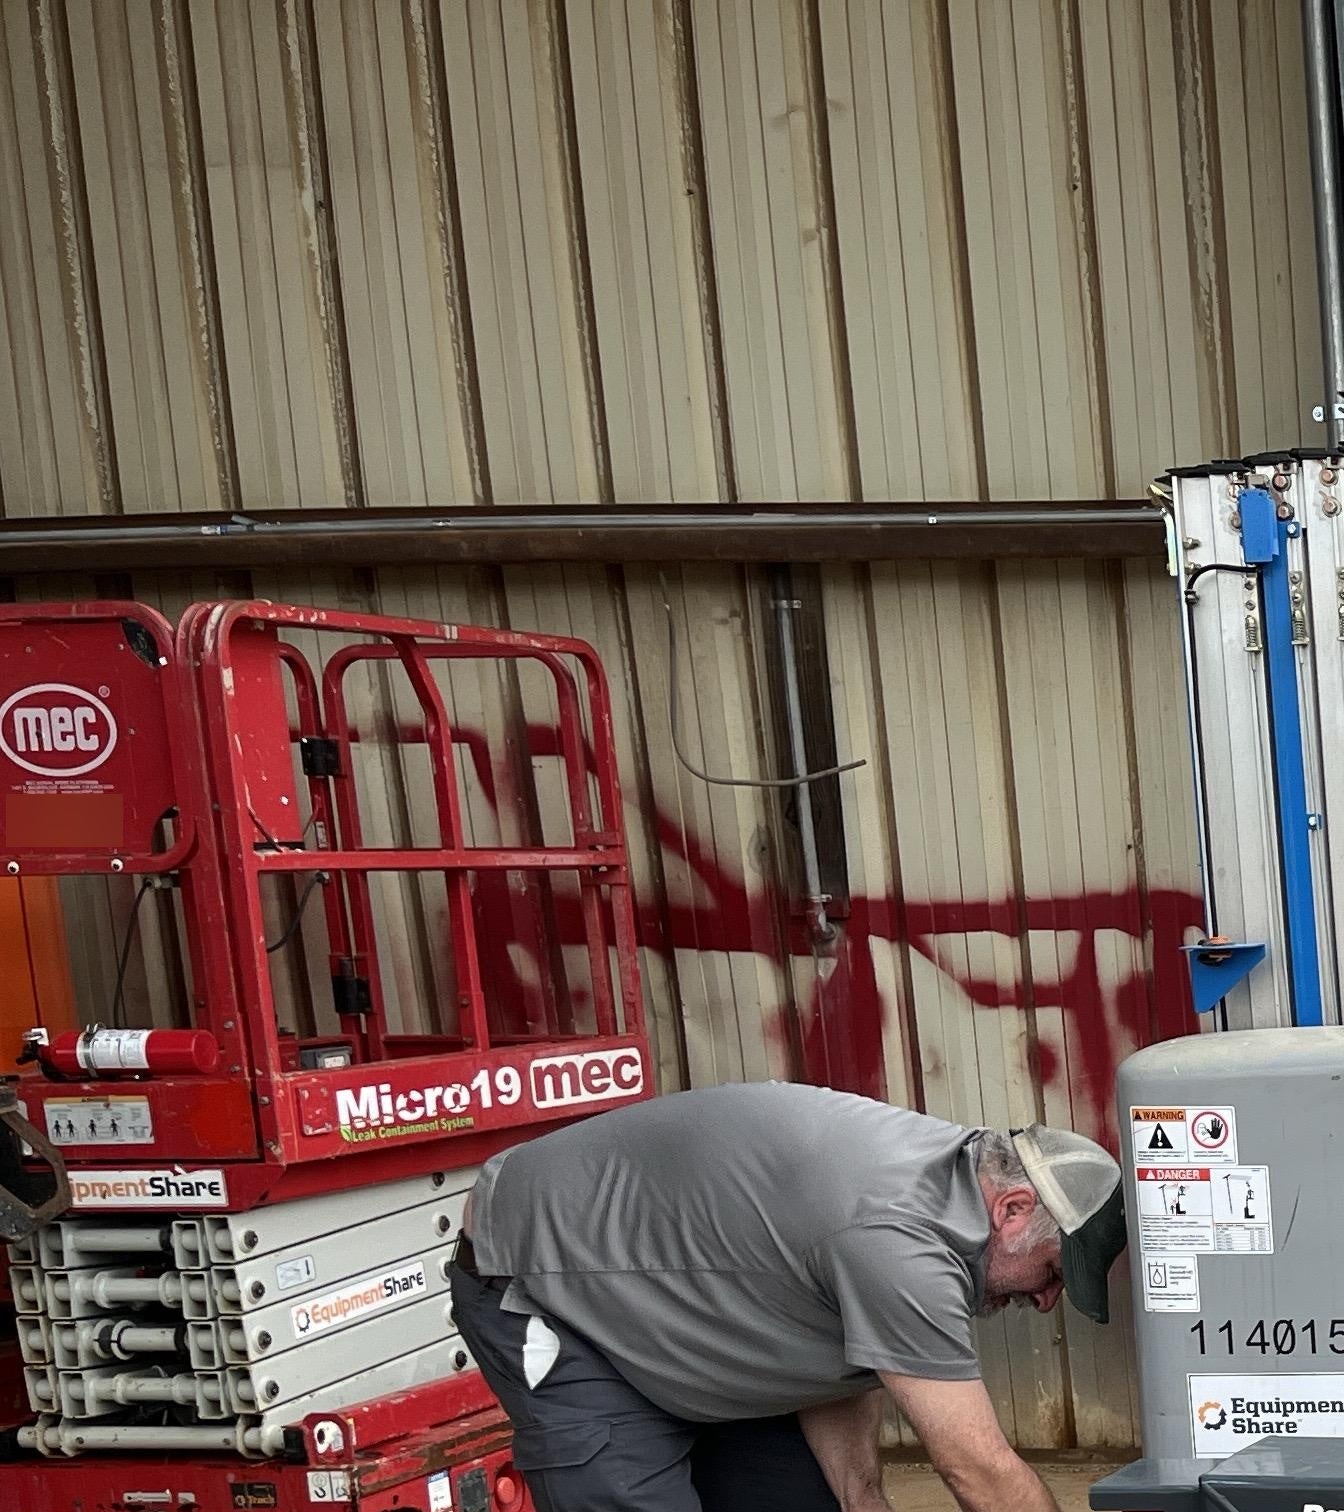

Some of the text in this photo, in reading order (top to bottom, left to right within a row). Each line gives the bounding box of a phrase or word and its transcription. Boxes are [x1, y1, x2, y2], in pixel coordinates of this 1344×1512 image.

[533, 1054, 642, 1102] mec
[378, 1120, 440, 1139] Containment
[441, 1115, 475, 1131] System
[1142, 1111, 1185, 1120] WARNING
[1156, 1169, 1200, 1180] DANGER
[69, 1176, 222, 1202] ipmentShare
[311, 1271, 425, 1324] EquipmentShare
[1231, 1418, 1299, 1434] Share
